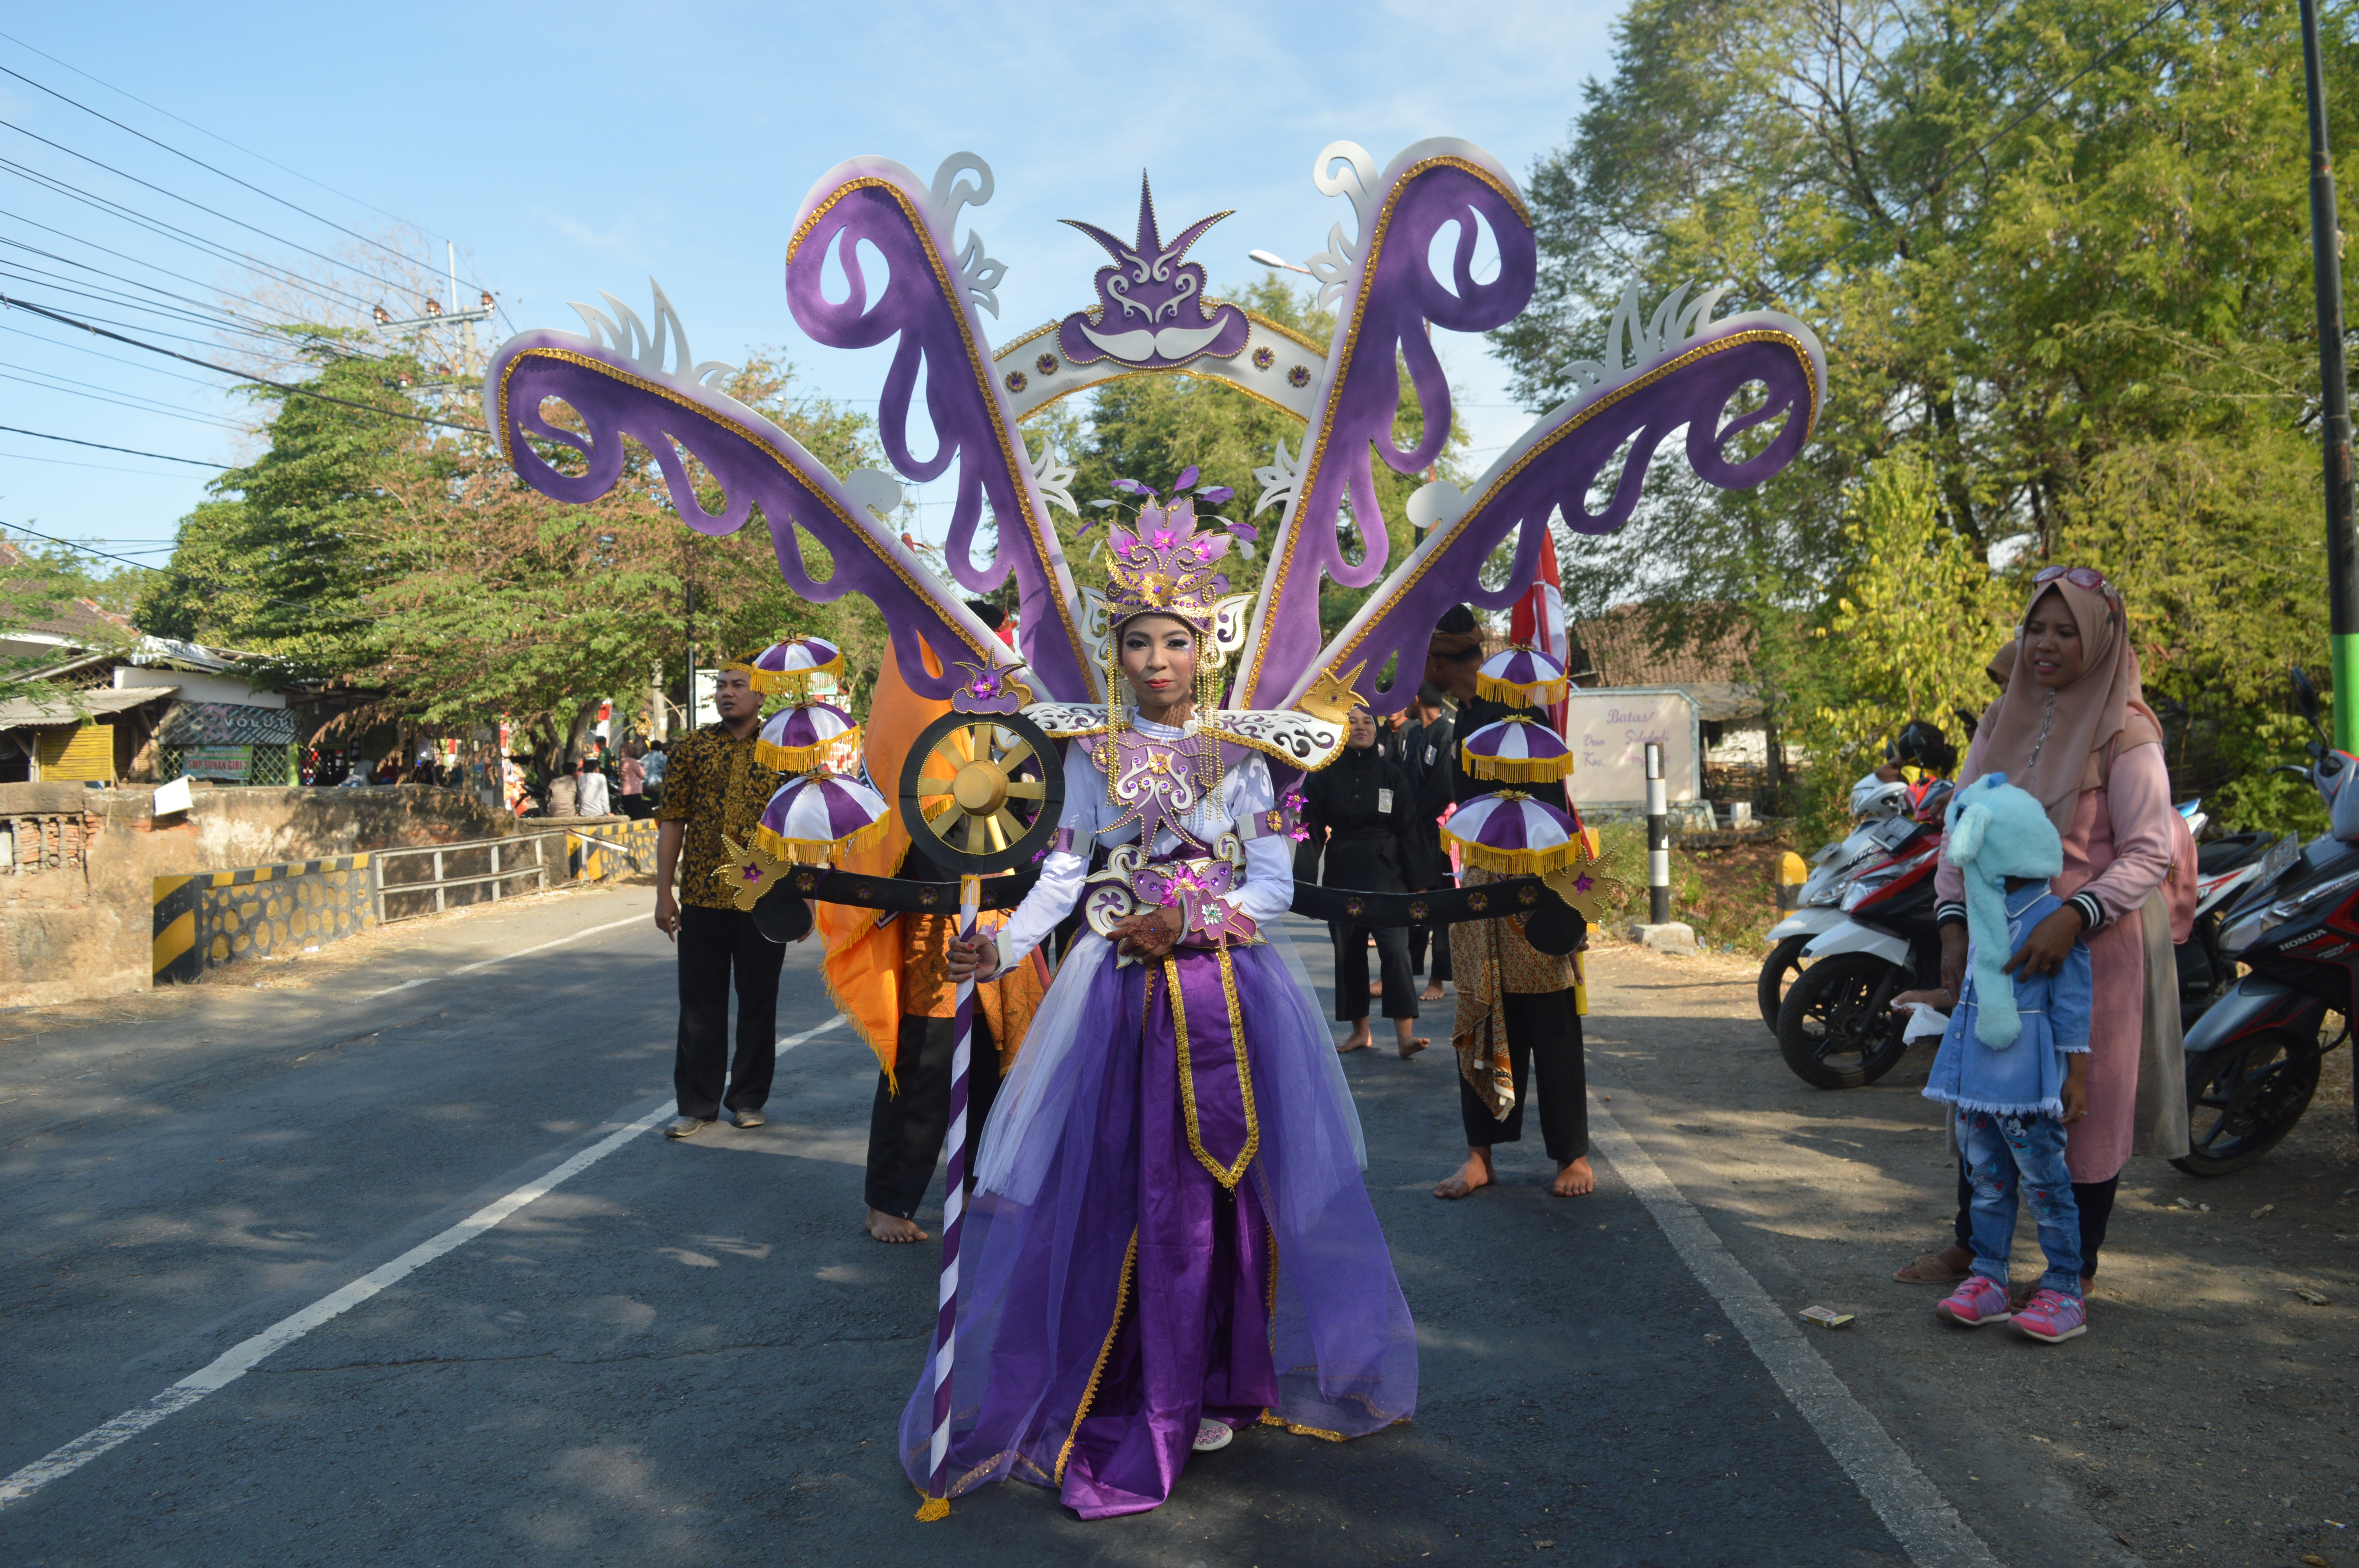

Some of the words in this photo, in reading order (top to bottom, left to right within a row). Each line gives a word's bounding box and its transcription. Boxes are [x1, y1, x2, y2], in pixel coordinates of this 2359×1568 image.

[1607, 710, 1654, 723] Batas
[1583, 734, 1605, 746] Desa
[187, 760, 202, 770] SMP
[204, 760, 226, 770] SUNAN
[228, 760, 242, 770] GIRI
[244, 760, 248, 770] 2
[2278, 929, 2328, 951] HONDA
